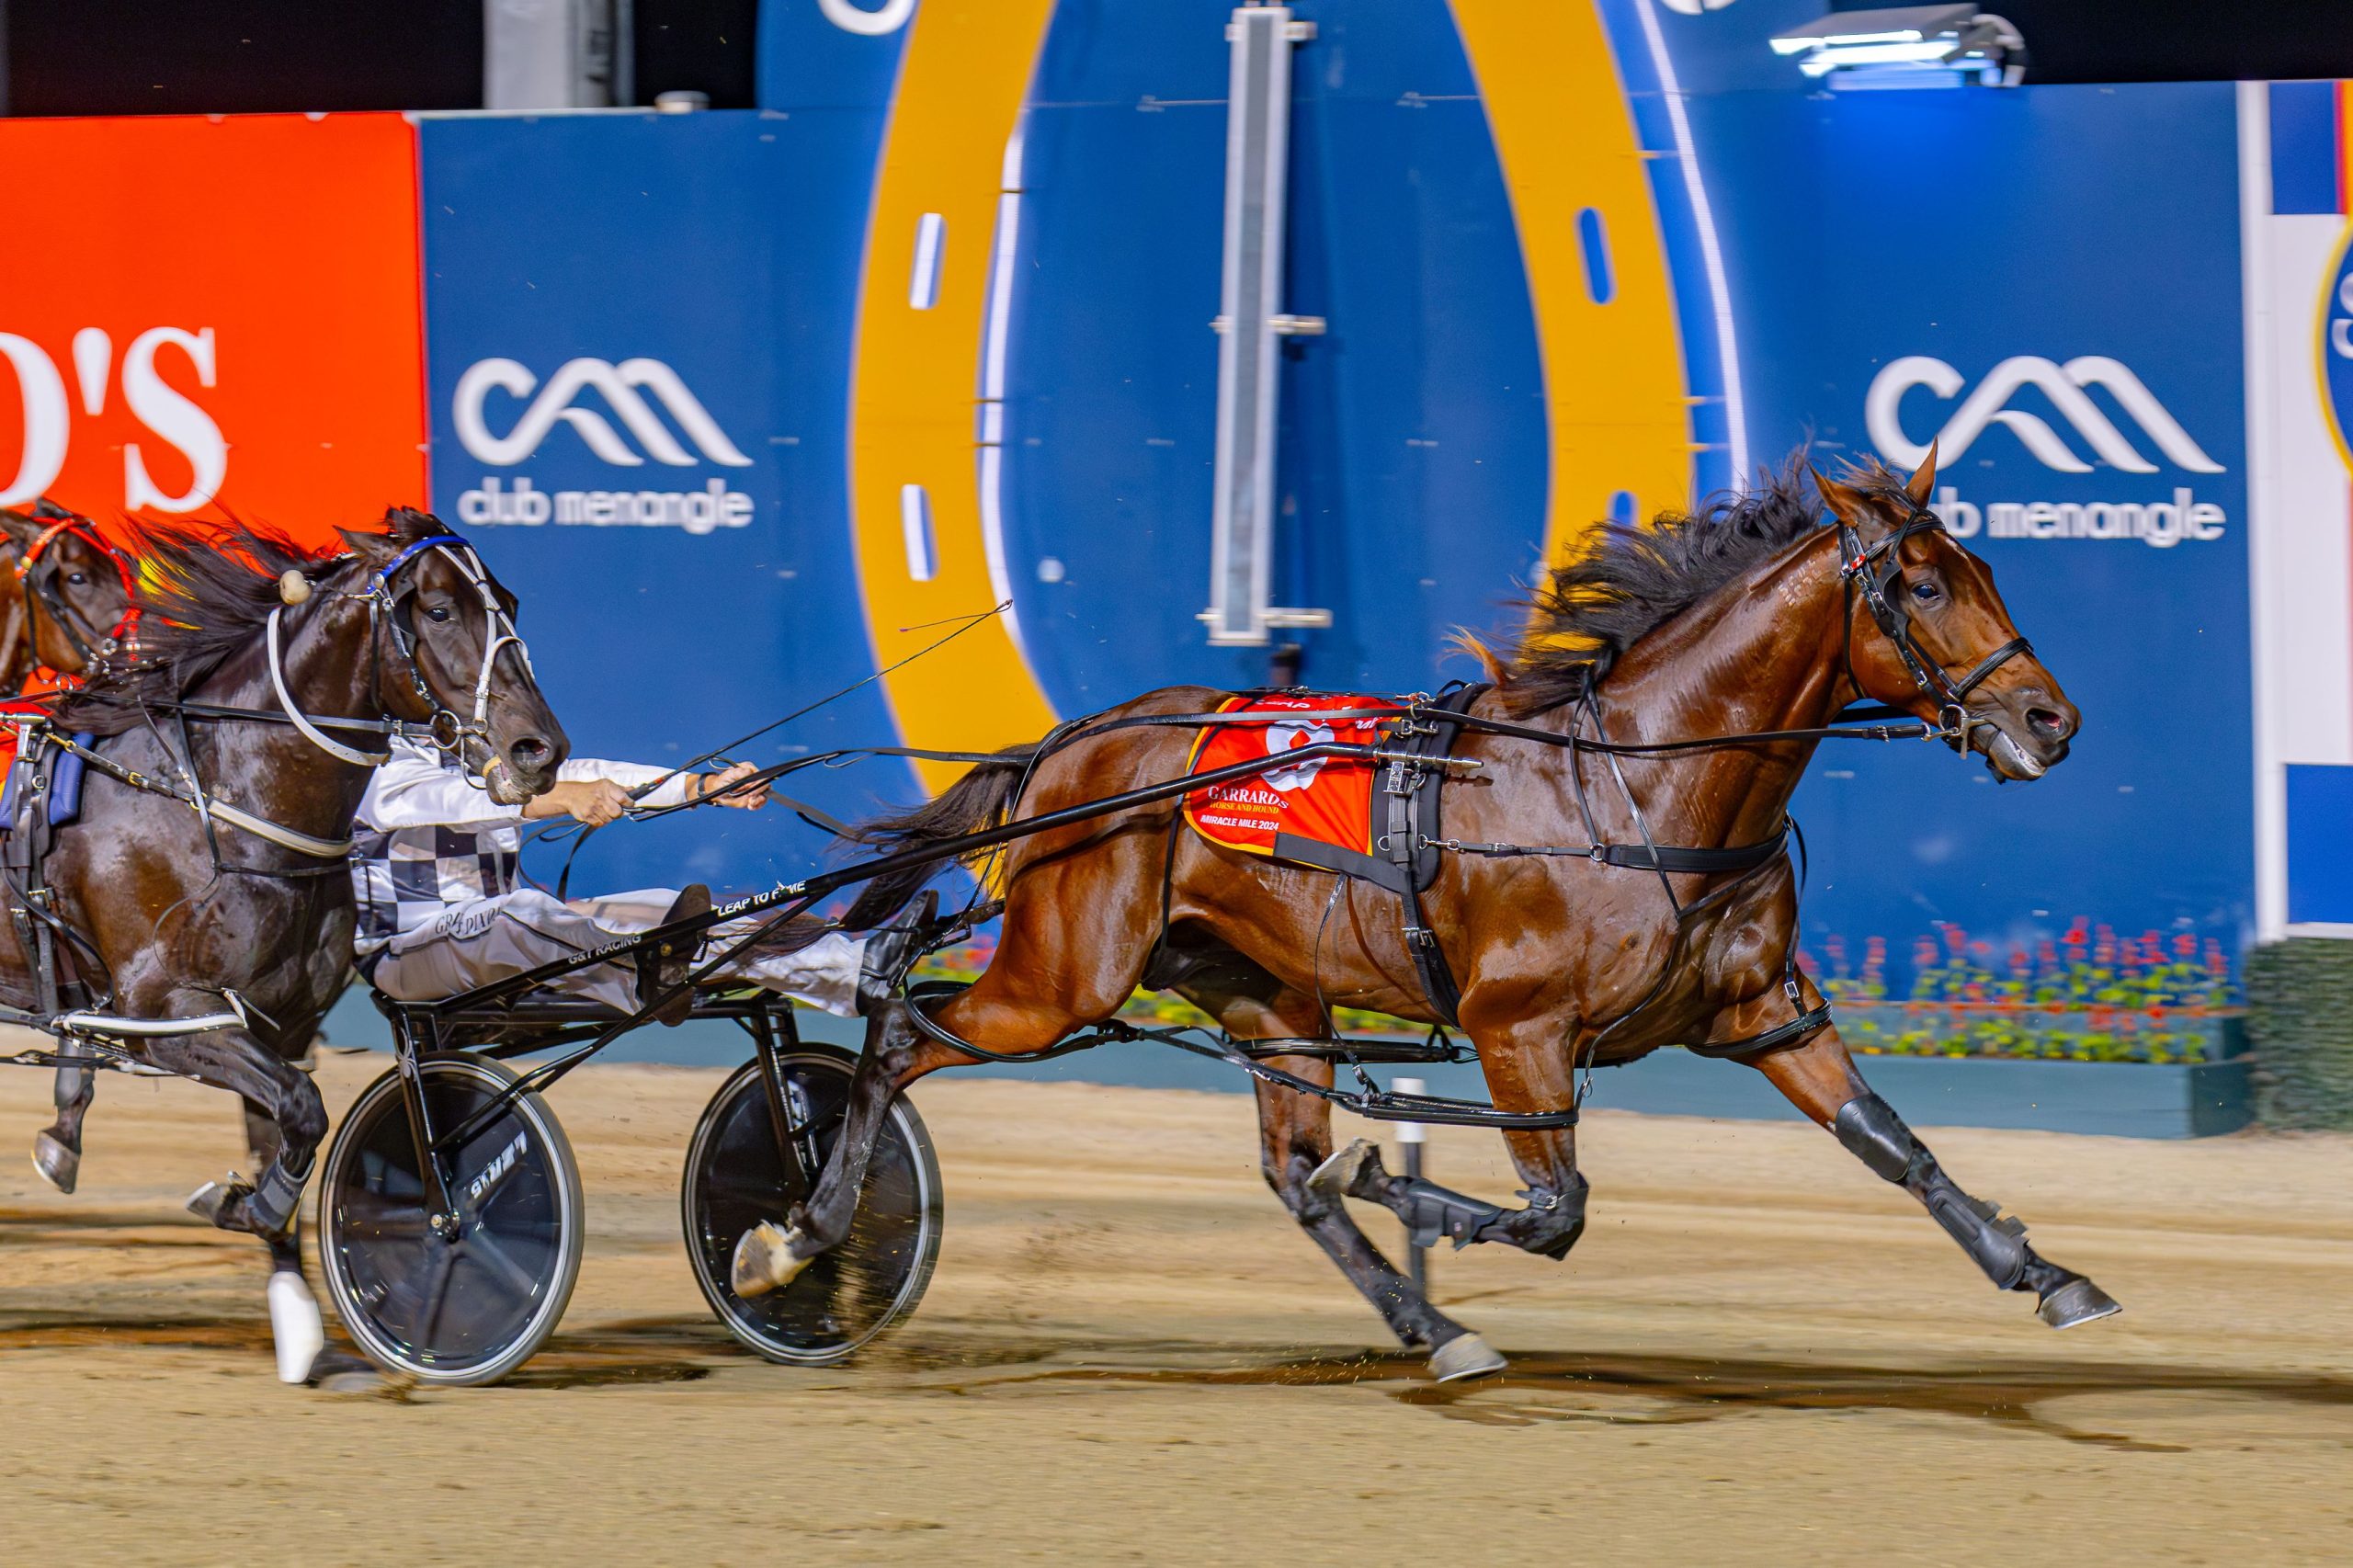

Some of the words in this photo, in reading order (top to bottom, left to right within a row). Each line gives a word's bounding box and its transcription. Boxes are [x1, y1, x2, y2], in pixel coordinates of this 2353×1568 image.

[457, 476, 551, 527] club
[553, 477, 756, 535] menangle
[1986, 487, 2227, 548] menangle
[1209, 800, 1236, 811] HORSE
[1236, 802, 1252, 812] AND
[1252, 804, 1279, 815] HOUND
[1199, 814, 1238, 827] MIRACLE
[1238, 818, 1258, 828] MILE
[1257, 820, 1280, 831] 2024
[717, 896, 752, 917] LEAP
[752, 892, 770, 905] TO
[595, 934, 642, 957] RACING
